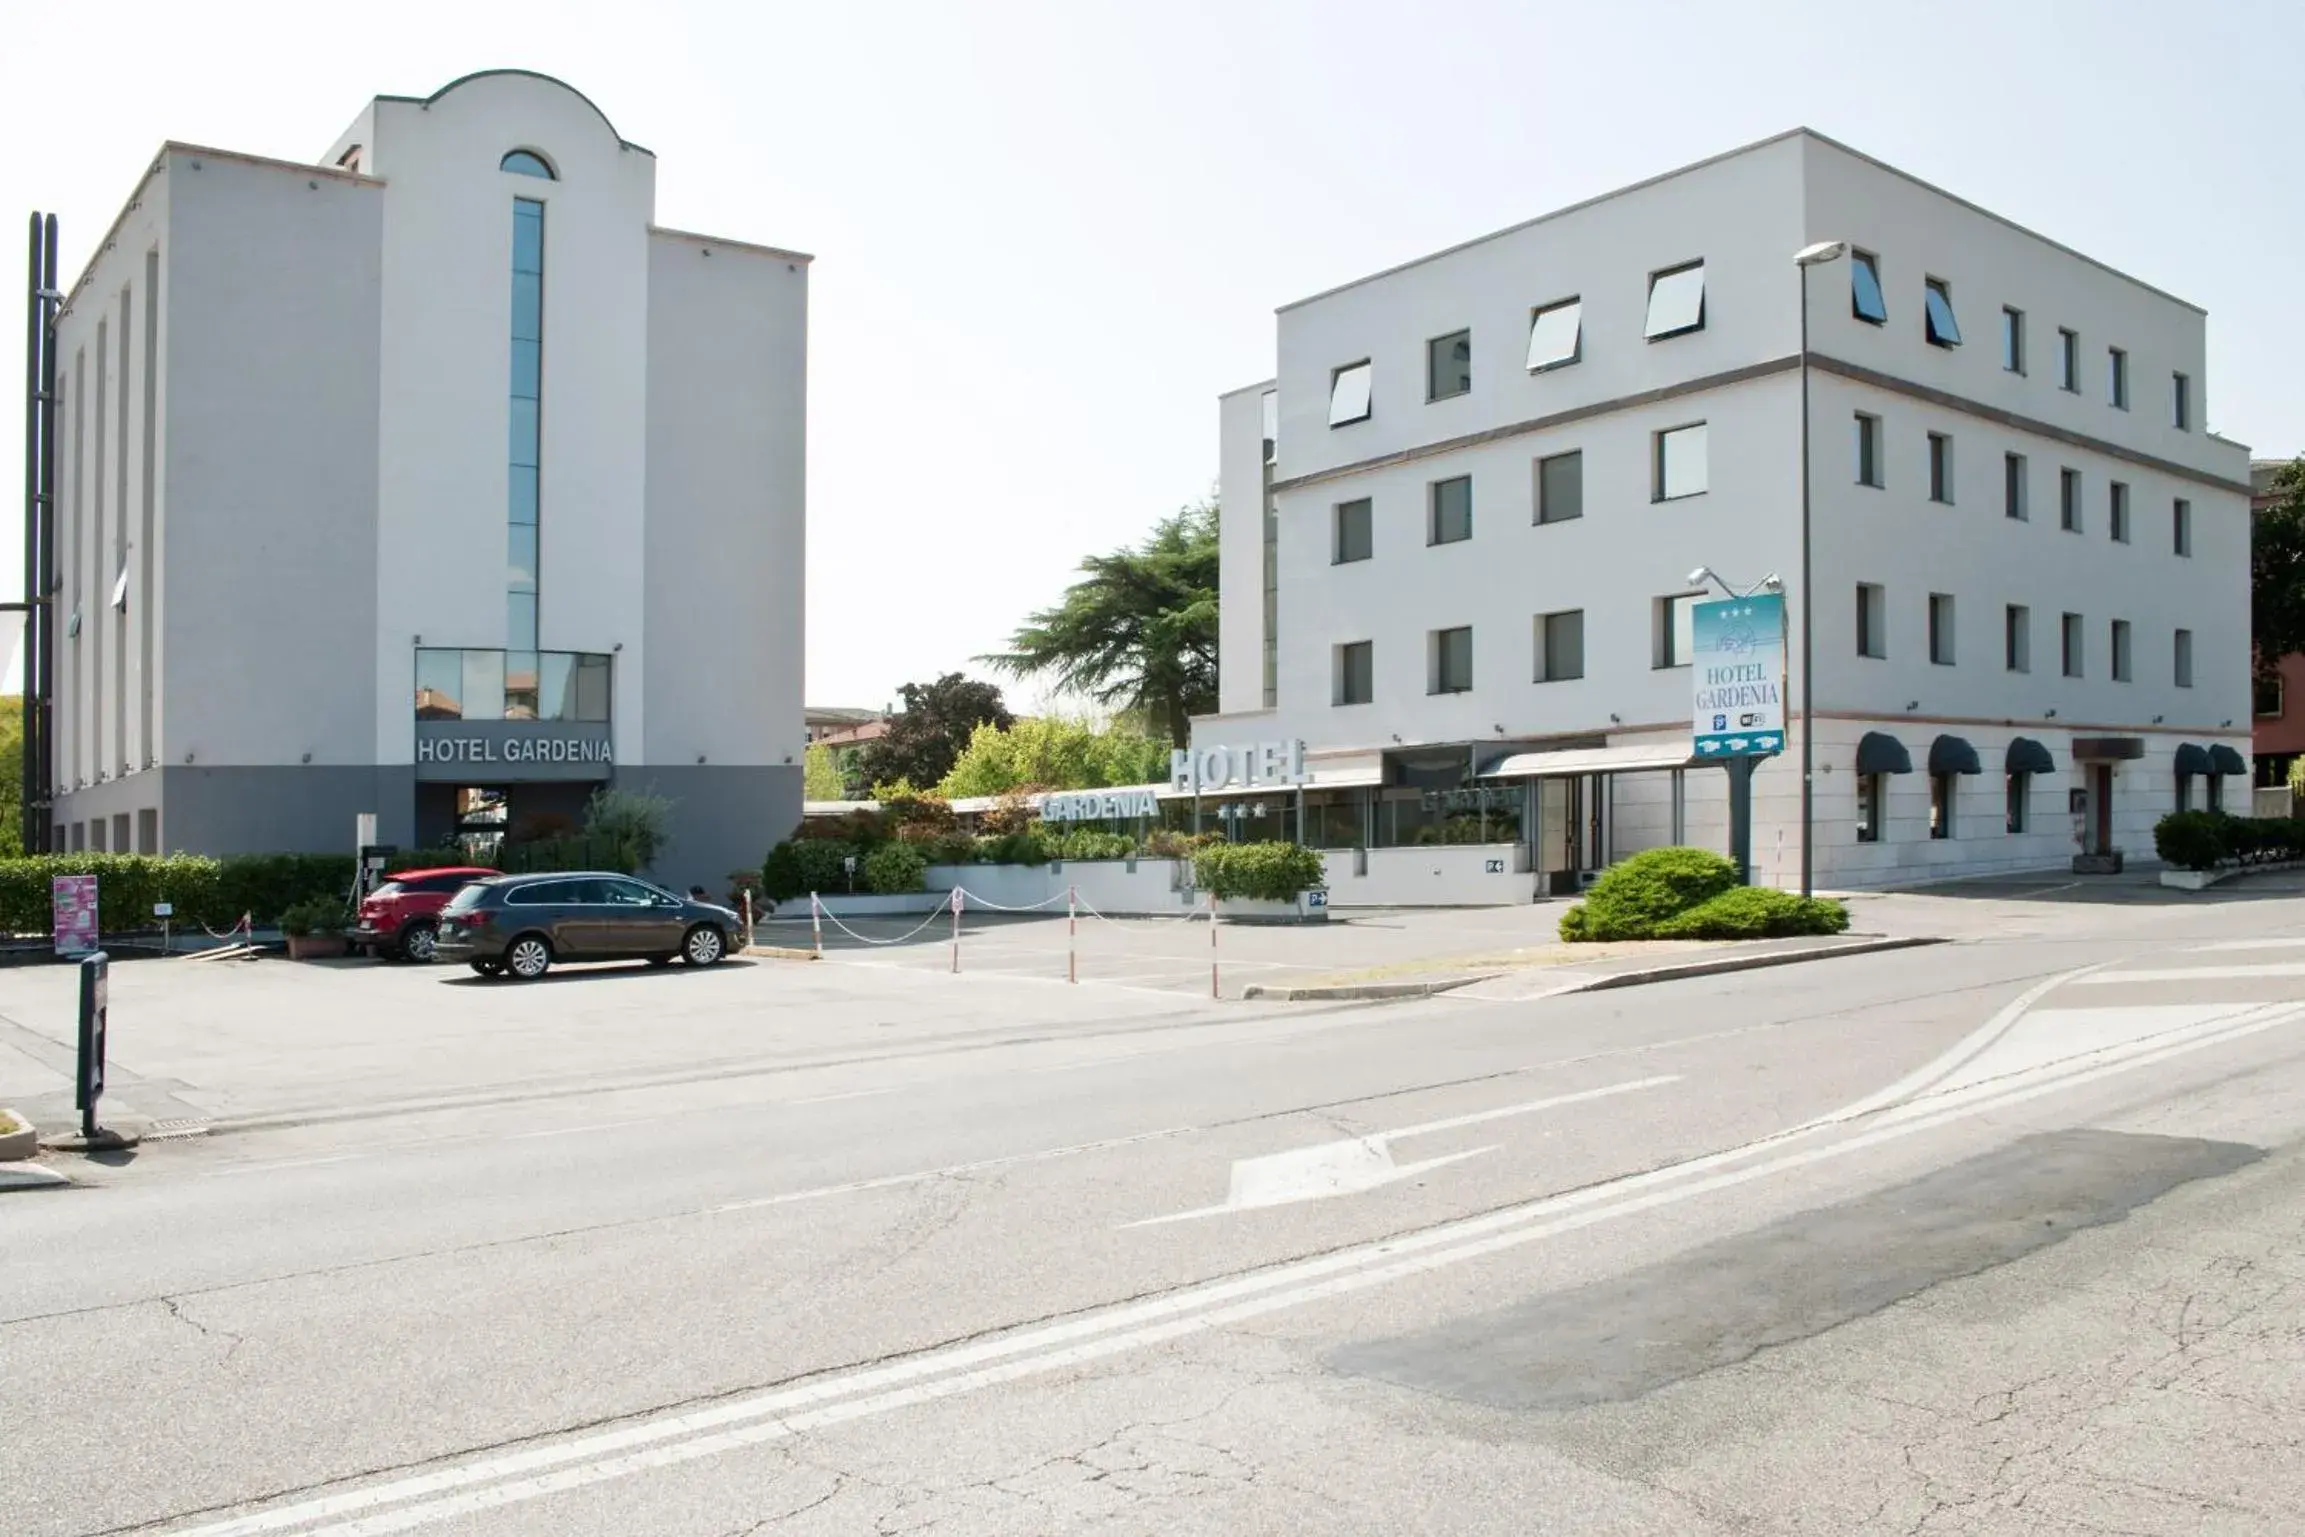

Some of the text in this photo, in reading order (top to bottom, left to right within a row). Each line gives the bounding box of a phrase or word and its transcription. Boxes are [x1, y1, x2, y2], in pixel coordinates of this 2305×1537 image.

[1707, 663, 1767, 686] HOTEL
[1696, 684, 1779, 710] GARDENIA
[418, 738, 613, 762] HOTEL GARDENIA
[1171, 739, 1314, 793] HOTEL
[1041, 790, 1160, 822] GARDENIA
